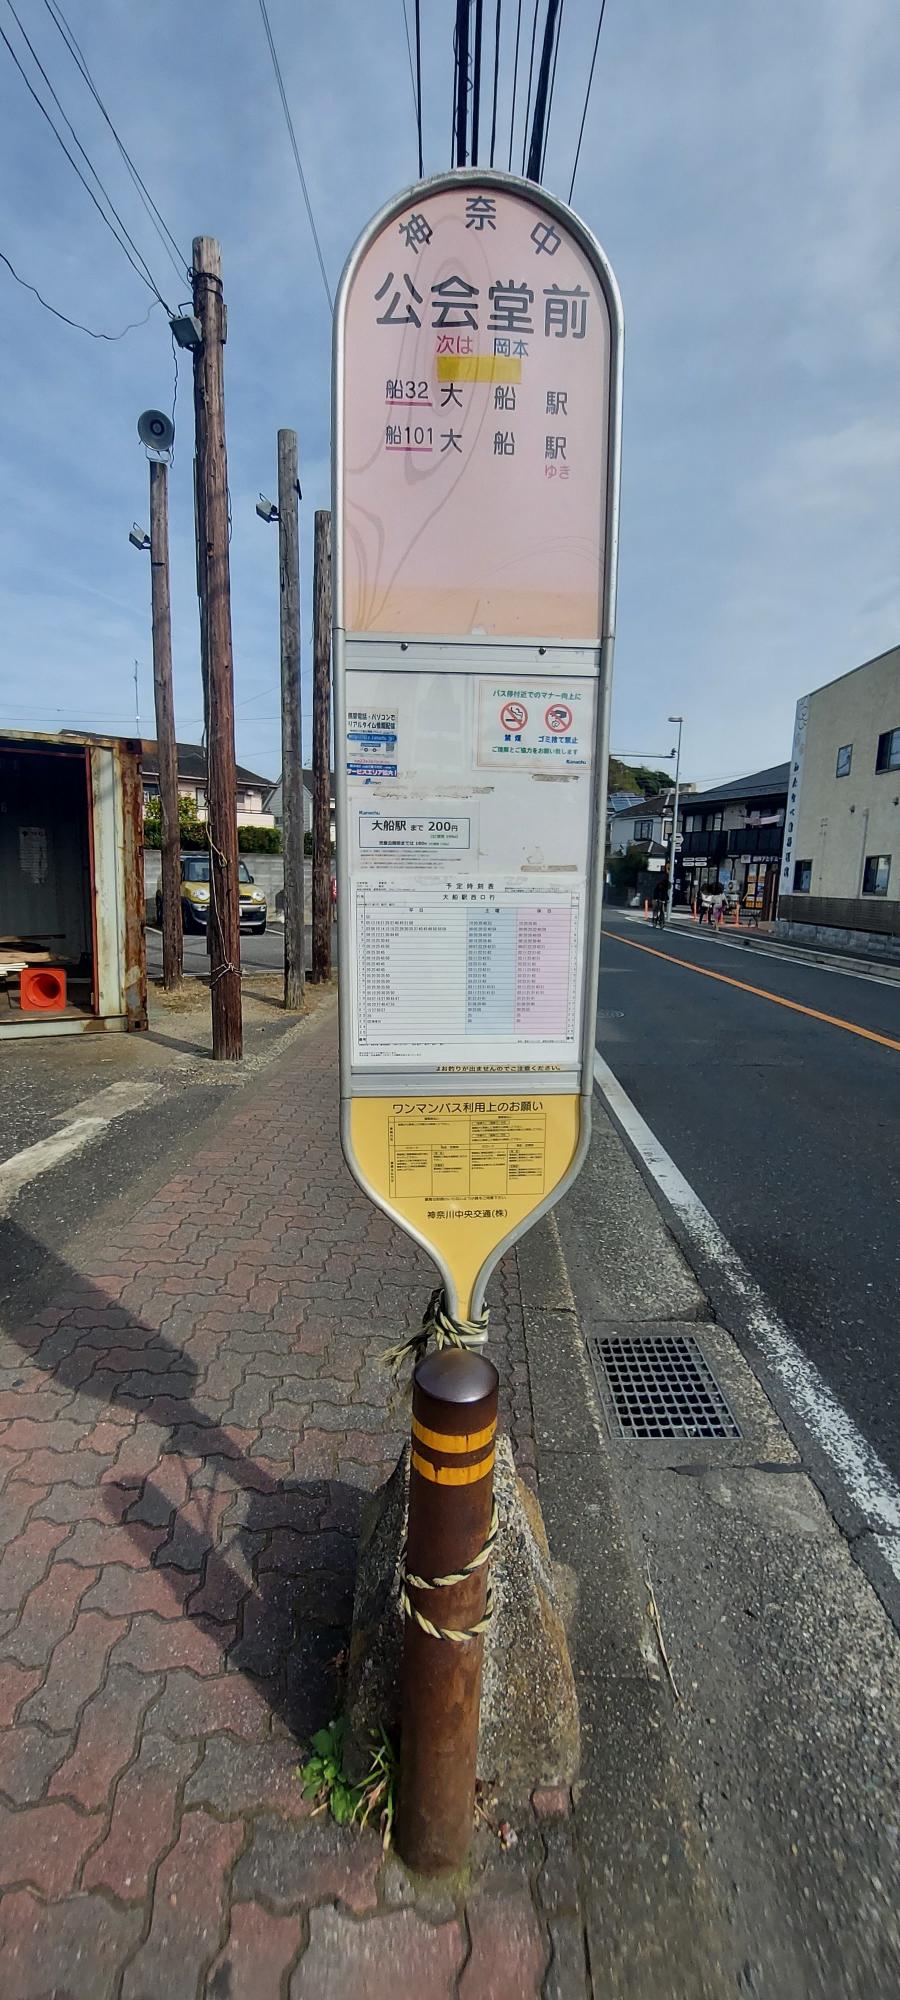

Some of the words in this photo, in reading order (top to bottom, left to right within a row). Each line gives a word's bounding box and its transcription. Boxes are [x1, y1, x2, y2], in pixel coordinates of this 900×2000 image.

[399, 196, 562, 256] 神奈中
[374, 272, 590, 339] 公会堂前
[436, 334, 474, 355] 次は
[493, 337, 529, 359] 岡本
[385, 380, 429, 400] 船32
[385, 425, 433, 446] 船101
[544, 464, 571, 480] ゆき
[371, 820, 407, 831] 大船駅
[428, 821, 458, 832] 200円
[392, 1101, 544, 1114] ワンマンバス利用上のお願い
[427, 1209, 508, 1219] 神奈川中央交通(株)
